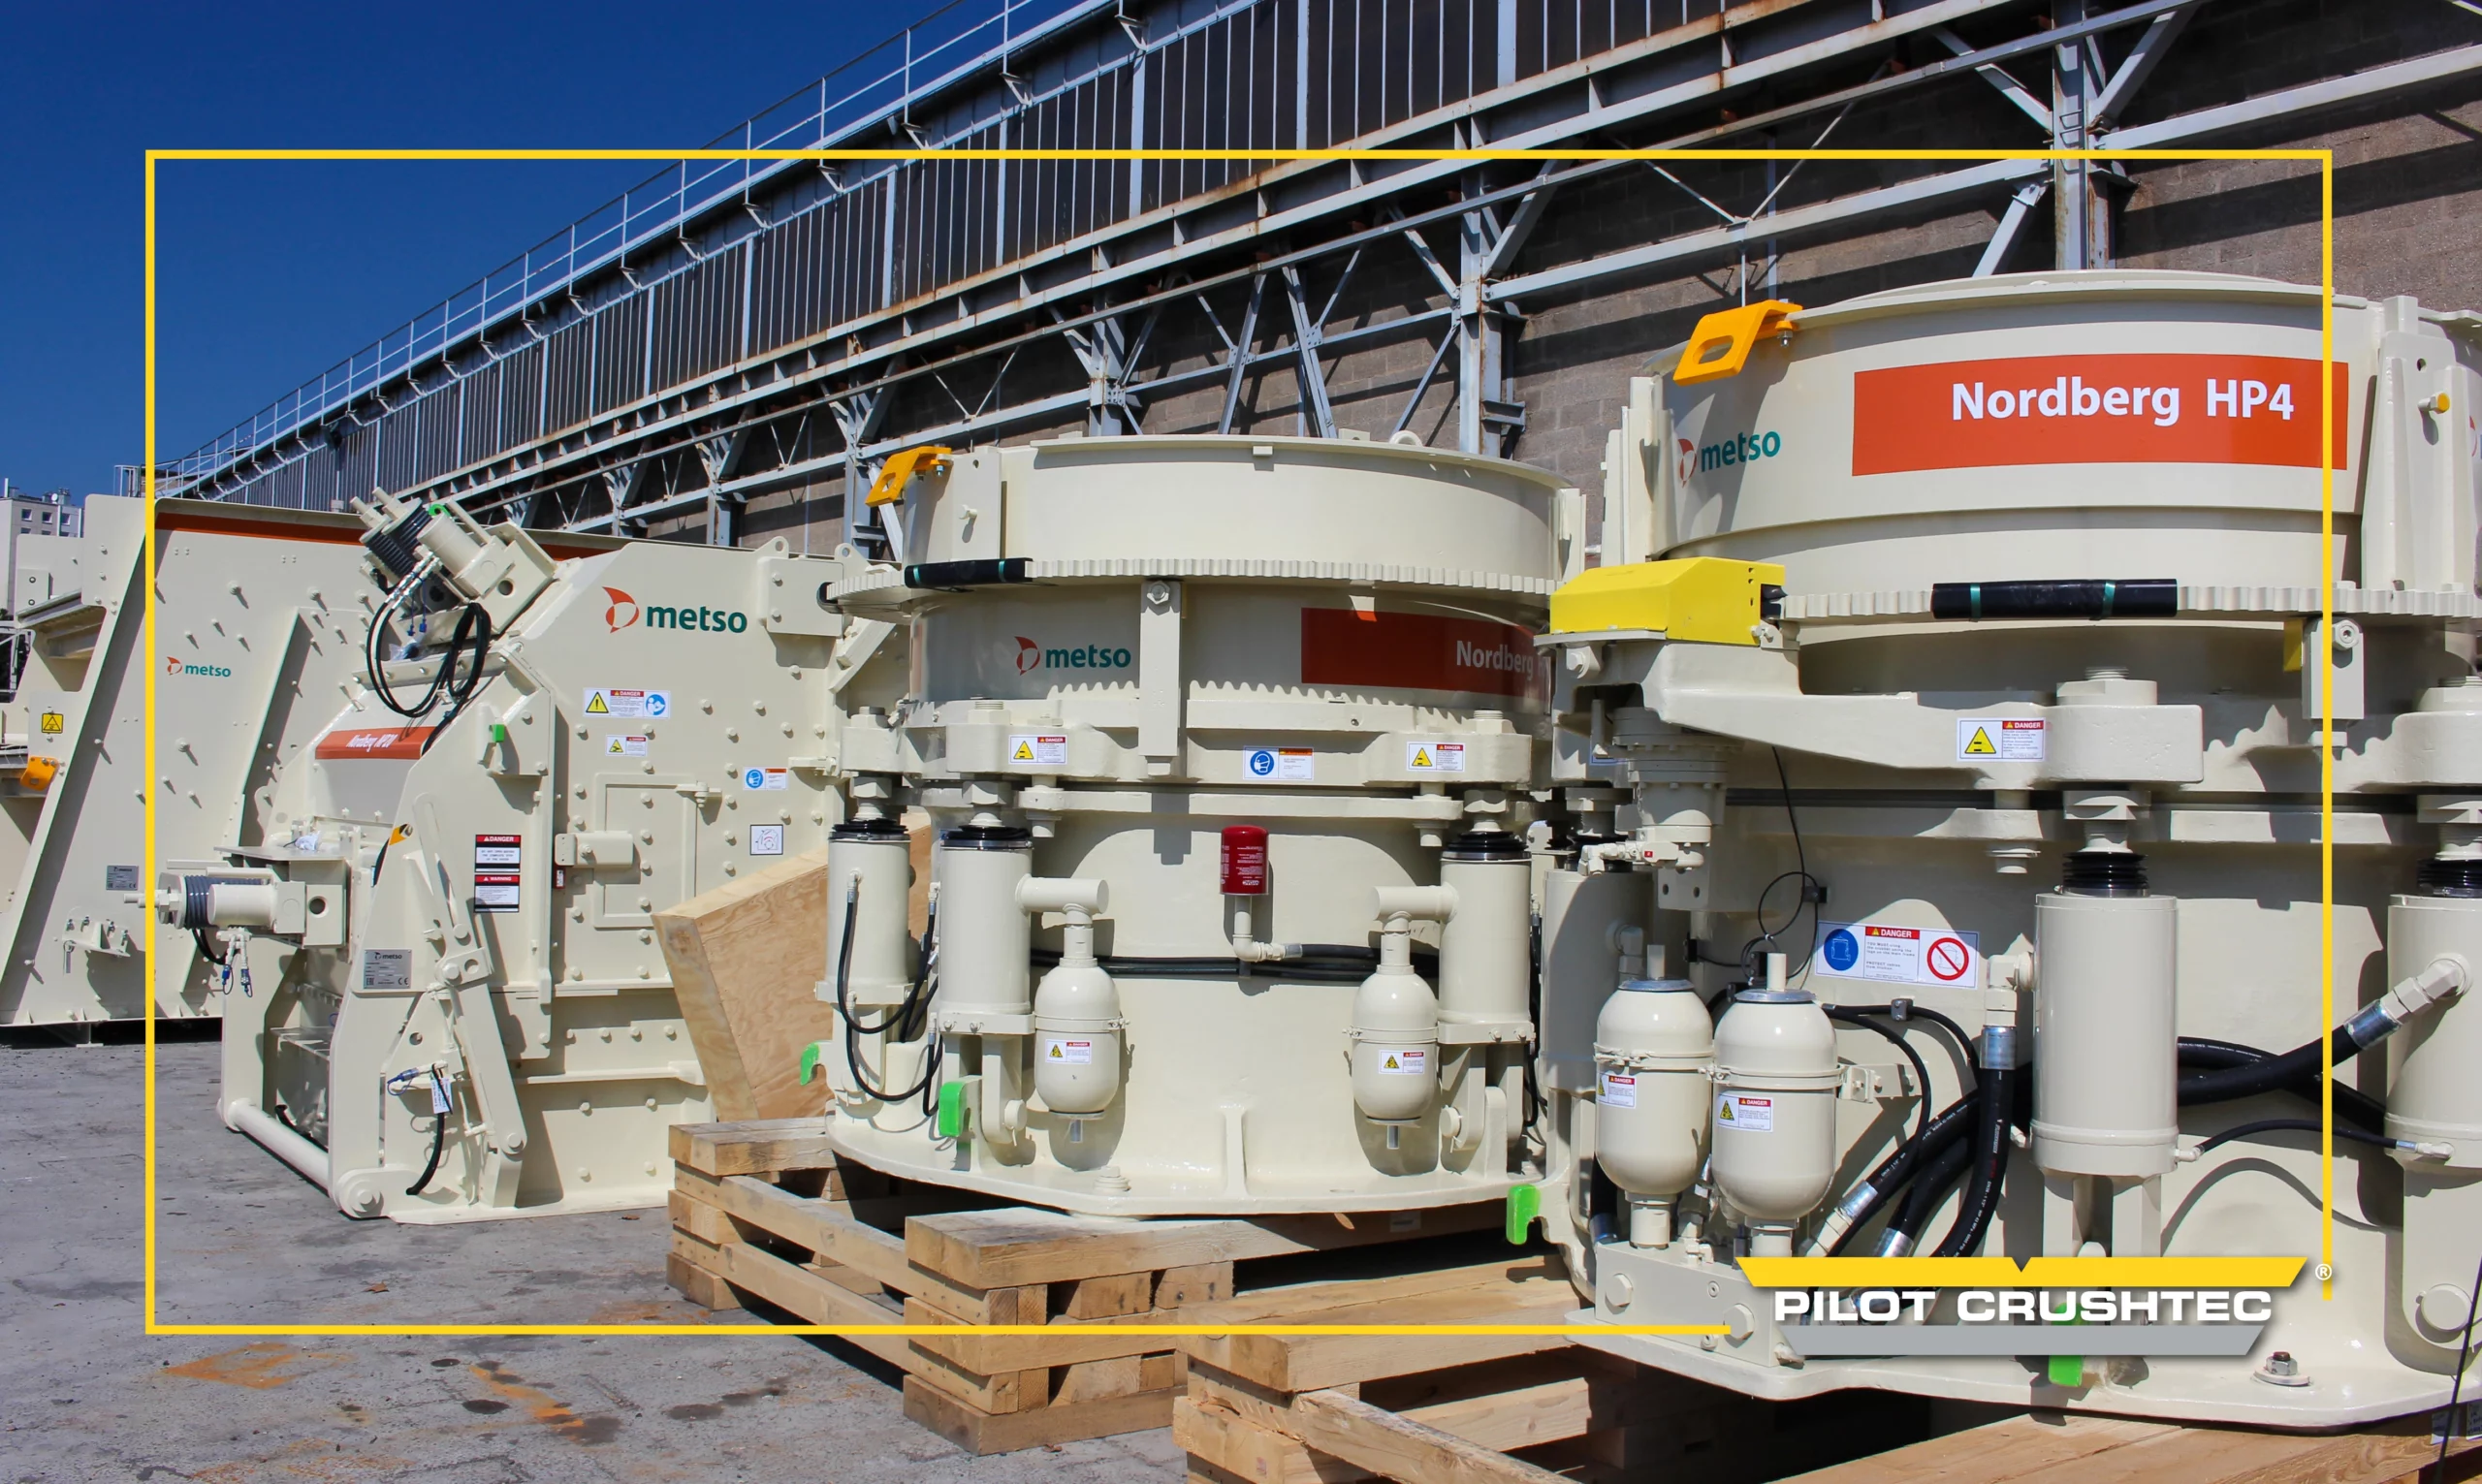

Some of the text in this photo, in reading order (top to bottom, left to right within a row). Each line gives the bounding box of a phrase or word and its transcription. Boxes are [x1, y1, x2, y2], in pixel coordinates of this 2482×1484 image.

[1952, 375, 2295, 427] Nordberg HP4
[1701, 430, 1781, 472] metso
[646, 606, 748, 634] metso
[1045, 644, 1131, 669] metso
[1456, 640, 1534, 680] Nordberg
[185, 664, 232, 678] metso
[1881, 929, 1912, 938] DANGER
